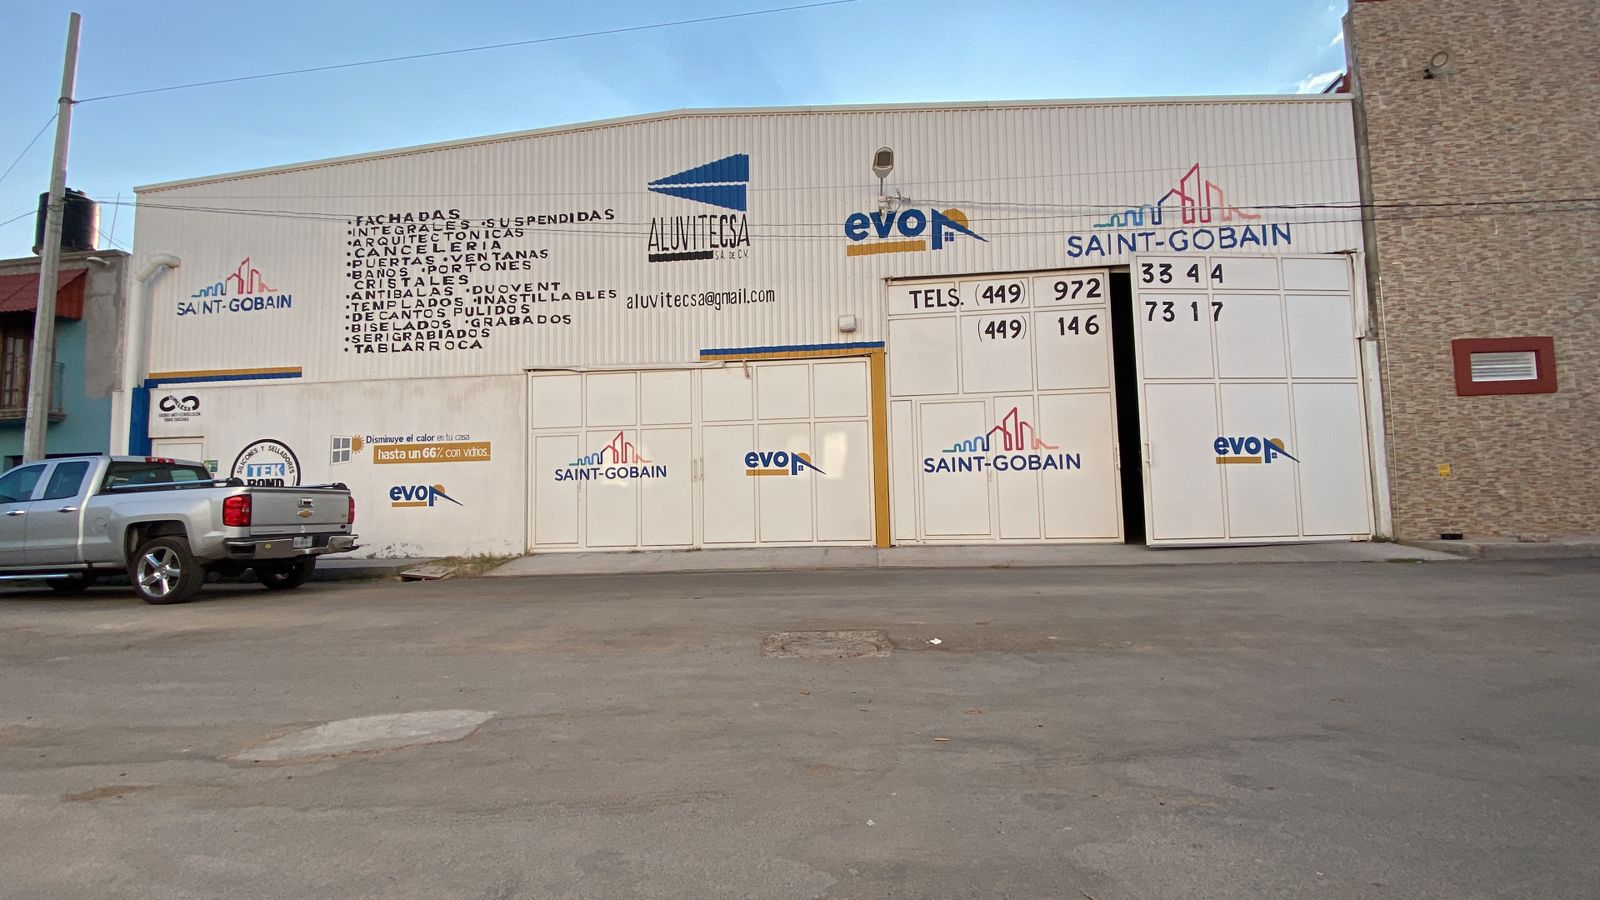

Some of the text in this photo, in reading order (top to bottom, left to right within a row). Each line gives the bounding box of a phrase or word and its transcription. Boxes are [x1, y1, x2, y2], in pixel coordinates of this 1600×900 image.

[356, 208, 615, 228] FACHADAS SUSPENDIDAS
[352, 220, 471, 238] INTEGRALES
[352, 228, 524, 248] ARQUITECTONICAS
[648, 213, 750, 251] ALUVITECSA
[354, 240, 502, 259] CANCELERIA
[1067, 221, 1292, 258] SAINT-GOBAIN
[352, 249, 549, 269] PUERTAS VENTANAS
[352, 260, 532, 280] BAÑOS PORTONES
[351, 281, 561, 301] ANTIBALAS DUOVENT
[354, 274, 469, 290] CRISTALES
[351, 289, 617, 312] TEMPLADOS INASTILLABLES
[627, 288, 775, 310] aluvitecsa@gmail.com
[909, 288, 964, 309] TELS.
[975, 281, 1026, 306] (449)
[1053, 278, 1102, 300] 972
[177, 294, 292, 316] SAINT-GOBAIN
[454, 303, 530, 317] PULIDOS
[351, 314, 572, 334] BISELADOS GRABADOS
[977, 319, 1027, 342] (449)
[1058, 314, 1100, 336] 146
[351, 328, 491, 343] SERIGRABIADOS
[354, 339, 483, 354] TABLARROCA
[366, 435, 404, 445] Disminuye
[406, 434, 413, 443] el
[416, 433, 435, 442] calor
[237, 447, 258, 474] SILICONES
[268, 445, 295, 474] SELLADORES
[378, 449, 406, 460] hasta
[408, 449, 421, 459] un
[422, 447, 443, 459] 66%
[445, 448, 461, 458] con
[923, 453, 1081, 473] SAINT-GOBAIN
[248, 464, 284, 476] TEK
[554, 465, 667, 481] SAINT-GOBAIN
